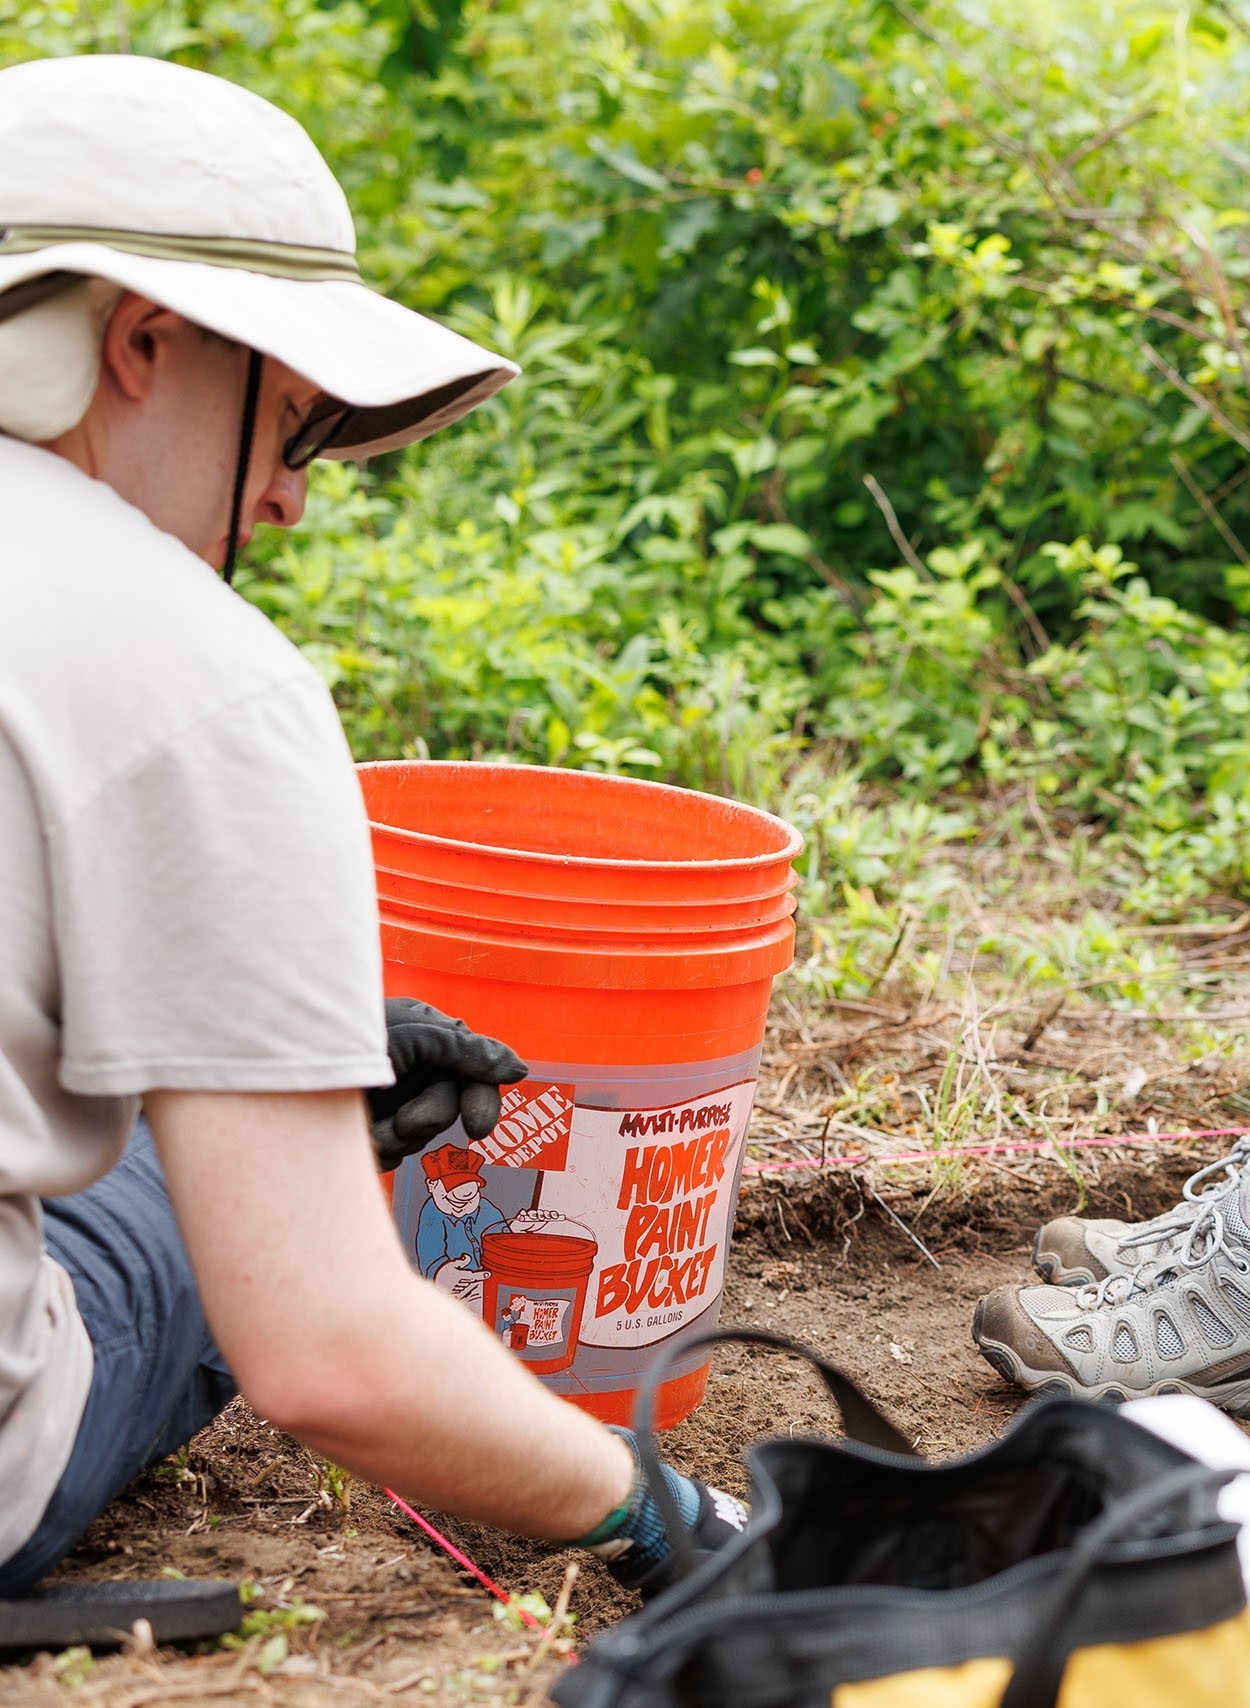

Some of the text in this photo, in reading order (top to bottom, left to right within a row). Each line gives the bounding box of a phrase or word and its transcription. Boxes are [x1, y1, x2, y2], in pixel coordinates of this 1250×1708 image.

[501, 1088, 527, 1117] HE
[618, 1101, 732, 1138] MULTI-PURPOSE
[469, 1085, 573, 1165] HOME
[503, 1117, 570, 1169] DEPOT
[616, 1127, 730, 1210] HOMER
[623, 1189, 718, 1263] PAINT
[594, 1243, 718, 1318] BUCKET
[533, 1307, 559, 1320] HOMER
[534, 1319, 556, 1330] PAINT
[616, 1310, 683, 1331] 5 U.S. GALLONS
[529, 1329, 558, 1341] BUCKET
